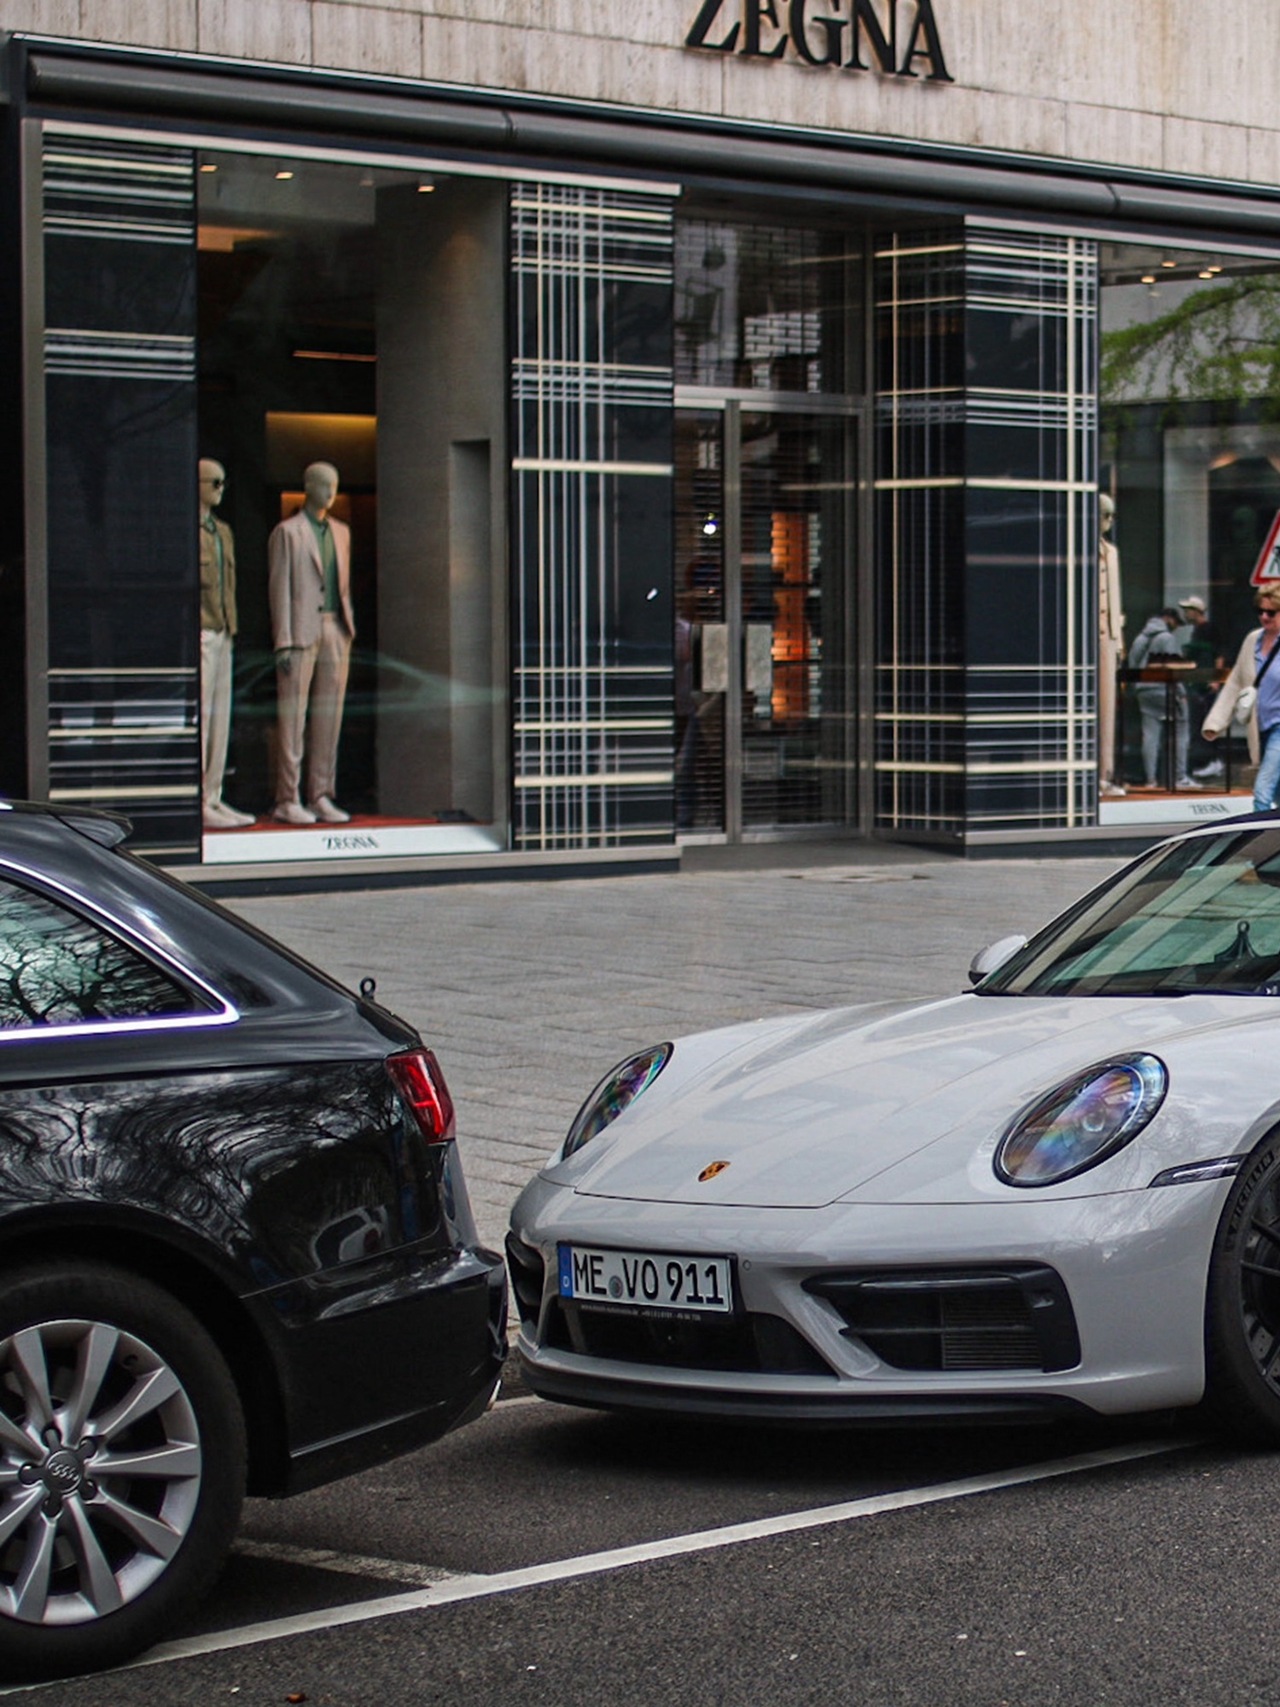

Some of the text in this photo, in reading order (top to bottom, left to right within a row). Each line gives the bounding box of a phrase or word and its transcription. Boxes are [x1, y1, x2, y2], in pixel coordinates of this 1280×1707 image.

[685, 0, 955, 82] ZEGNA
[322, 835, 379, 850] ZEGNA
[573, 1252, 608, 1295] ME
[621, 1257, 659, 1301] VO
[666, 1261, 725, 1305] 911
